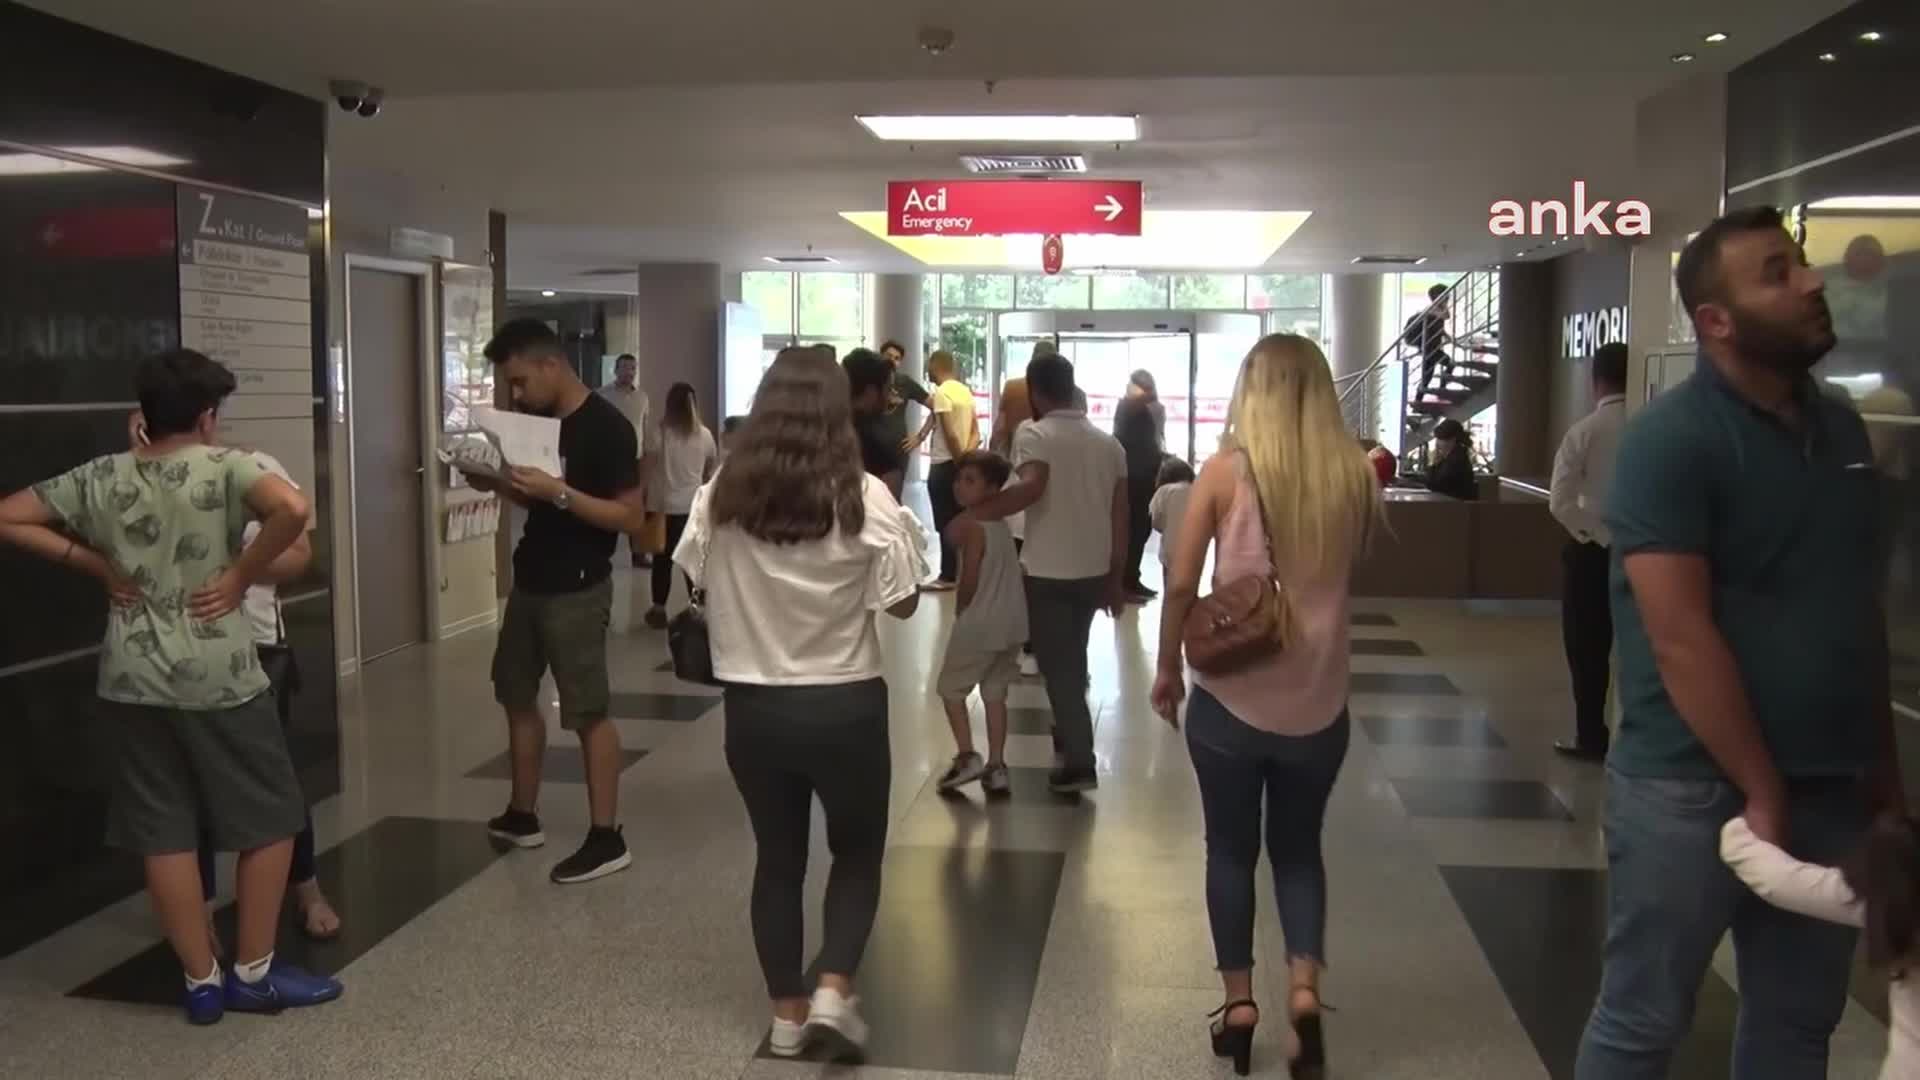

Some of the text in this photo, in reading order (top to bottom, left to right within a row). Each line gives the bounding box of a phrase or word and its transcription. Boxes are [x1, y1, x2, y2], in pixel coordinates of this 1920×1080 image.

[903, 187, 946, 212] Acil
[902, 214, 973, 231] Emergency
[1562, 305, 1627, 358] MEMORI
